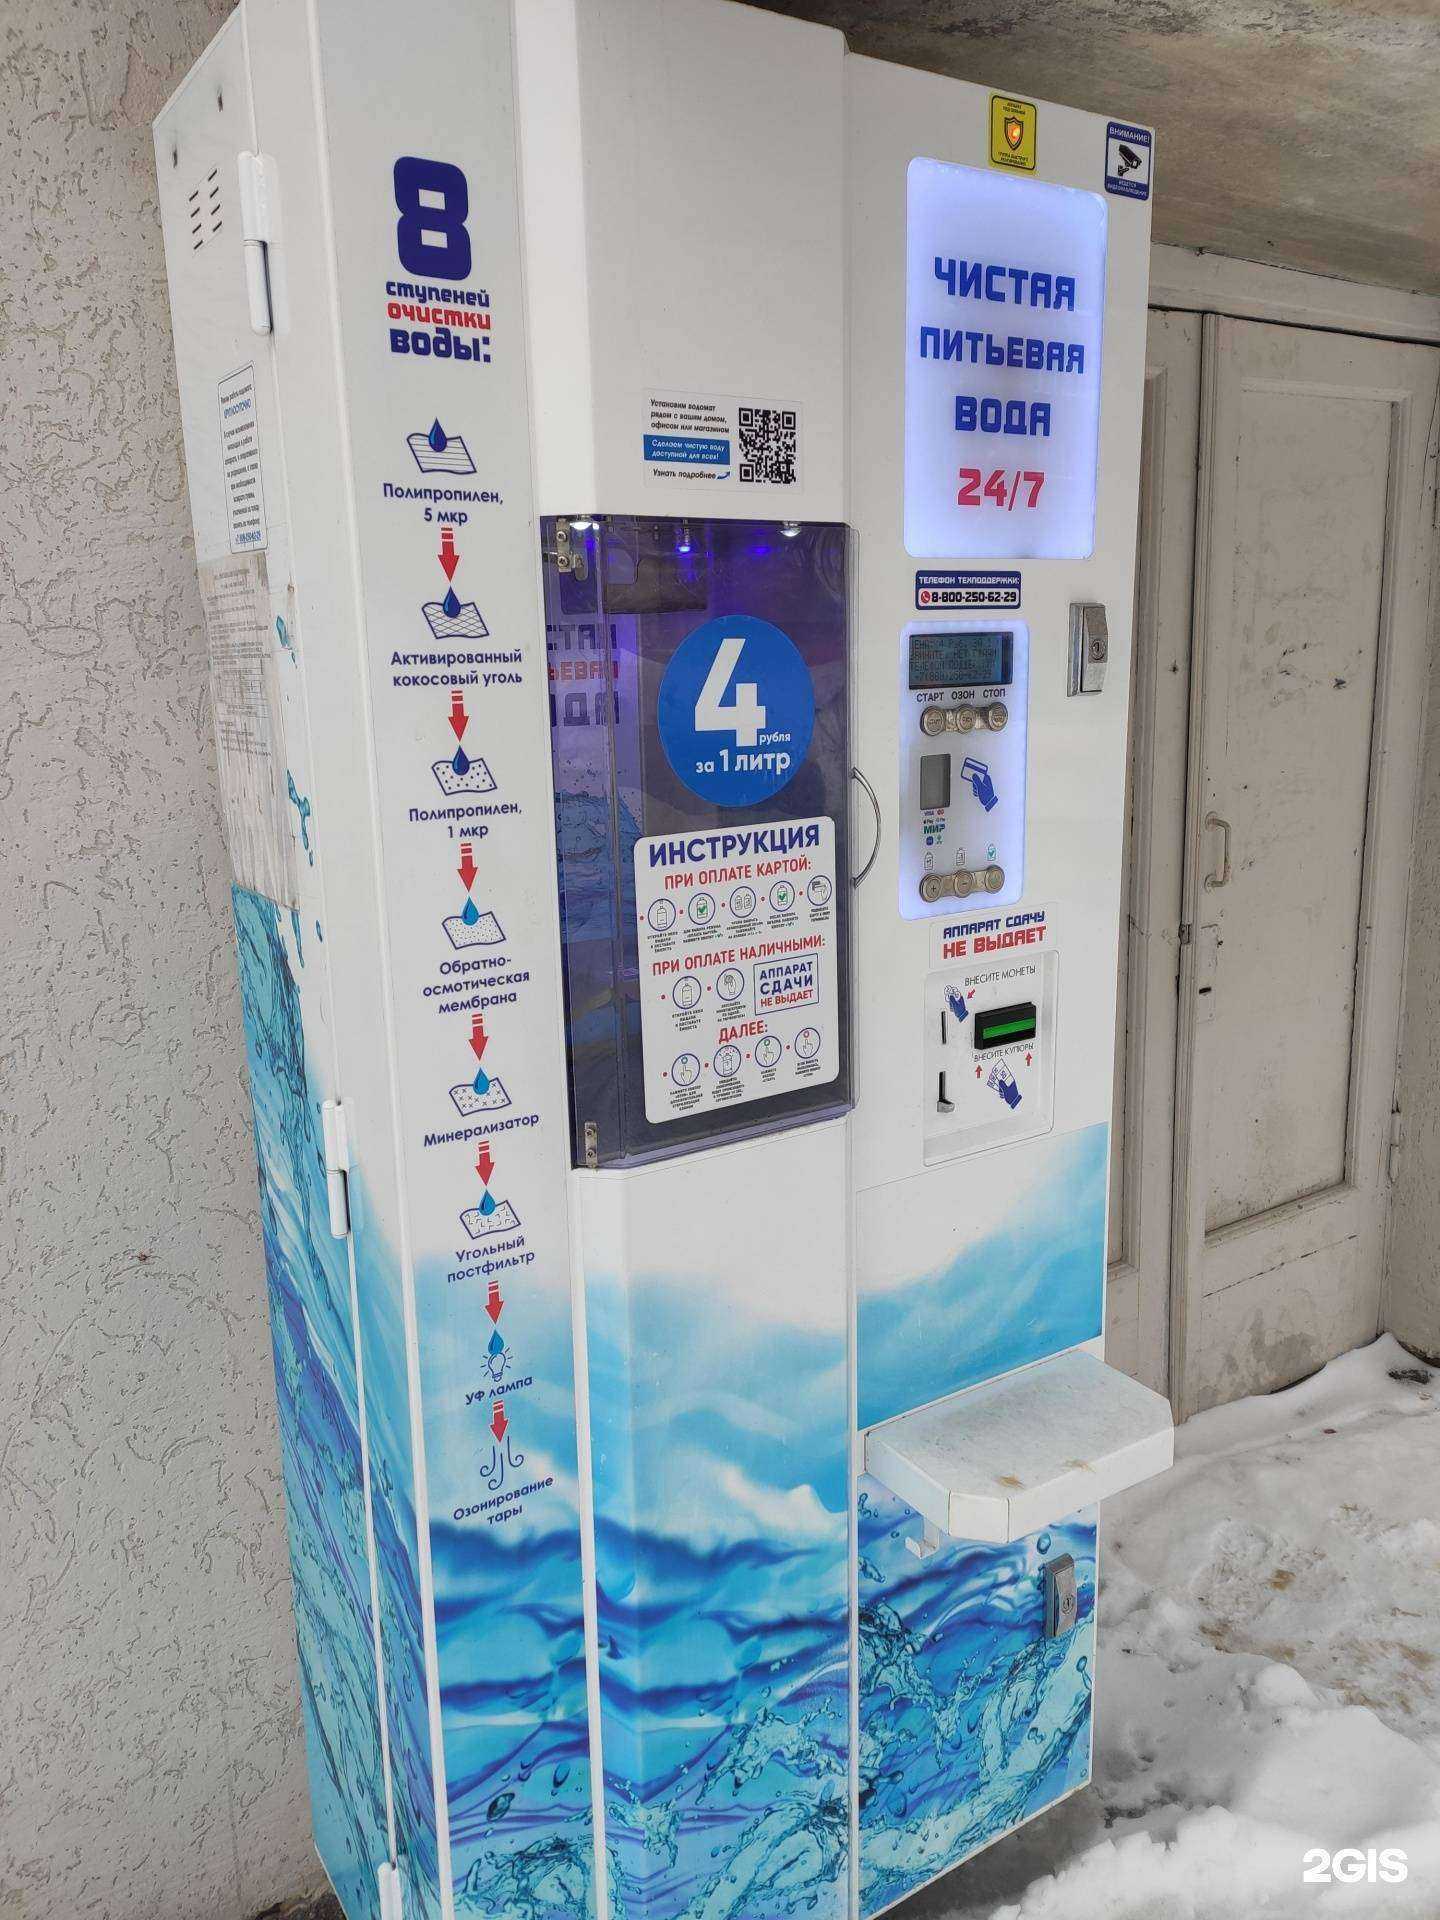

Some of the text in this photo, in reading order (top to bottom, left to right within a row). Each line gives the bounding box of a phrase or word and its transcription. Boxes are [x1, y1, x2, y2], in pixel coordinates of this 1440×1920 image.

[1110, 126, 1150, 143] ВНИМАНИЕ!
[393, 156, 472, 280] 8
[386, 281, 490, 308] ступеней
[934, 256, 1076, 312] ЧИСТАЯ
[387, 302, 491, 330] очистки
[390, 327, 491, 363] воды:
[920, 325, 1085, 375] ПИТЬЕВАЯ
[650, 399, 686, 409] Установим
[650, 412, 671, 420] рядом
[704, 416, 727, 424] домом,
[651, 421, 679, 430] офисом
[955, 395, 1051, 437] ВОДА
[652, 439, 682, 448] Сделаем
[684, 443, 708, 451] чистую
[652, 450, 687, 458] доступной
[653, 468, 716, 479] Узнать подробнее
[383, 483, 503, 505] Полипропилен,
[957, 467, 1046, 511] 24/7
[424, 508, 468, 526] 5 мкр
[919, 576, 1020, 584] ТЕЛЕФОН ТЕХПОДДЕРЖКИ:
[932, 591, 1017, 603] 8-800-250-62-29
[391, 649, 522, 667] Активированный
[393, 669, 522, 688] кокосовый уголь
[694, 638, 766, 746] 4
[916, 688, 1006, 702] СТАРТ ОЗОН СТОП
[760, 732, 791, 746] рубля
[696, 749, 792, 775] за 1 литр
[409, 803, 522, 822] Полипропилен,
[448, 825, 489, 840] 1 мкр
[924, 824, 946, 834] МИР
[650, 824, 820, 868] ИНСТРУКЦИЯ
[664, 854, 812, 890] ПРИ ОПЛАТЕ КАРТОЙ:
[944, 910, 1045, 939] АППАРАТ СДАЧУ
[943, 926, 1046, 959] НЕ ВЫДАЕТ
[440, 956, 512, 976] Обратно-
[652, 960, 680, 976] ПРИ
[684, 949, 735, 970] ОПЛАТЕ
[740, 934, 826, 960] НАЛИЧНЫМИ:
[760, 961, 813, 980] АППАРАТ
[964, 965, 1036, 986] ВНЕСИТЕ МОНЕТЫ
[422, 971, 530, 998] осмотическая
[760, 975, 813, 996] СДАЧИ
[438, 992, 518, 1014] мембрана
[760, 989, 813, 1007] НЕ ВЫДАЕТ
[718, 1020, 768, 1045] ДАЛЕЕ:
[974, 1043, 1034, 1062] ВНЕСИТЕ КУПЮРЫ
[424, 1113, 540, 1148] Минерализатор
[456, 1235, 525, 1263] Угольный
[448, 1252, 536, 1284] постфильтр
[489, 1376, 534, 1400] лампа
[453, 1476, 554, 1521] Озонирование
[486, 1504, 523, 1526] тары
